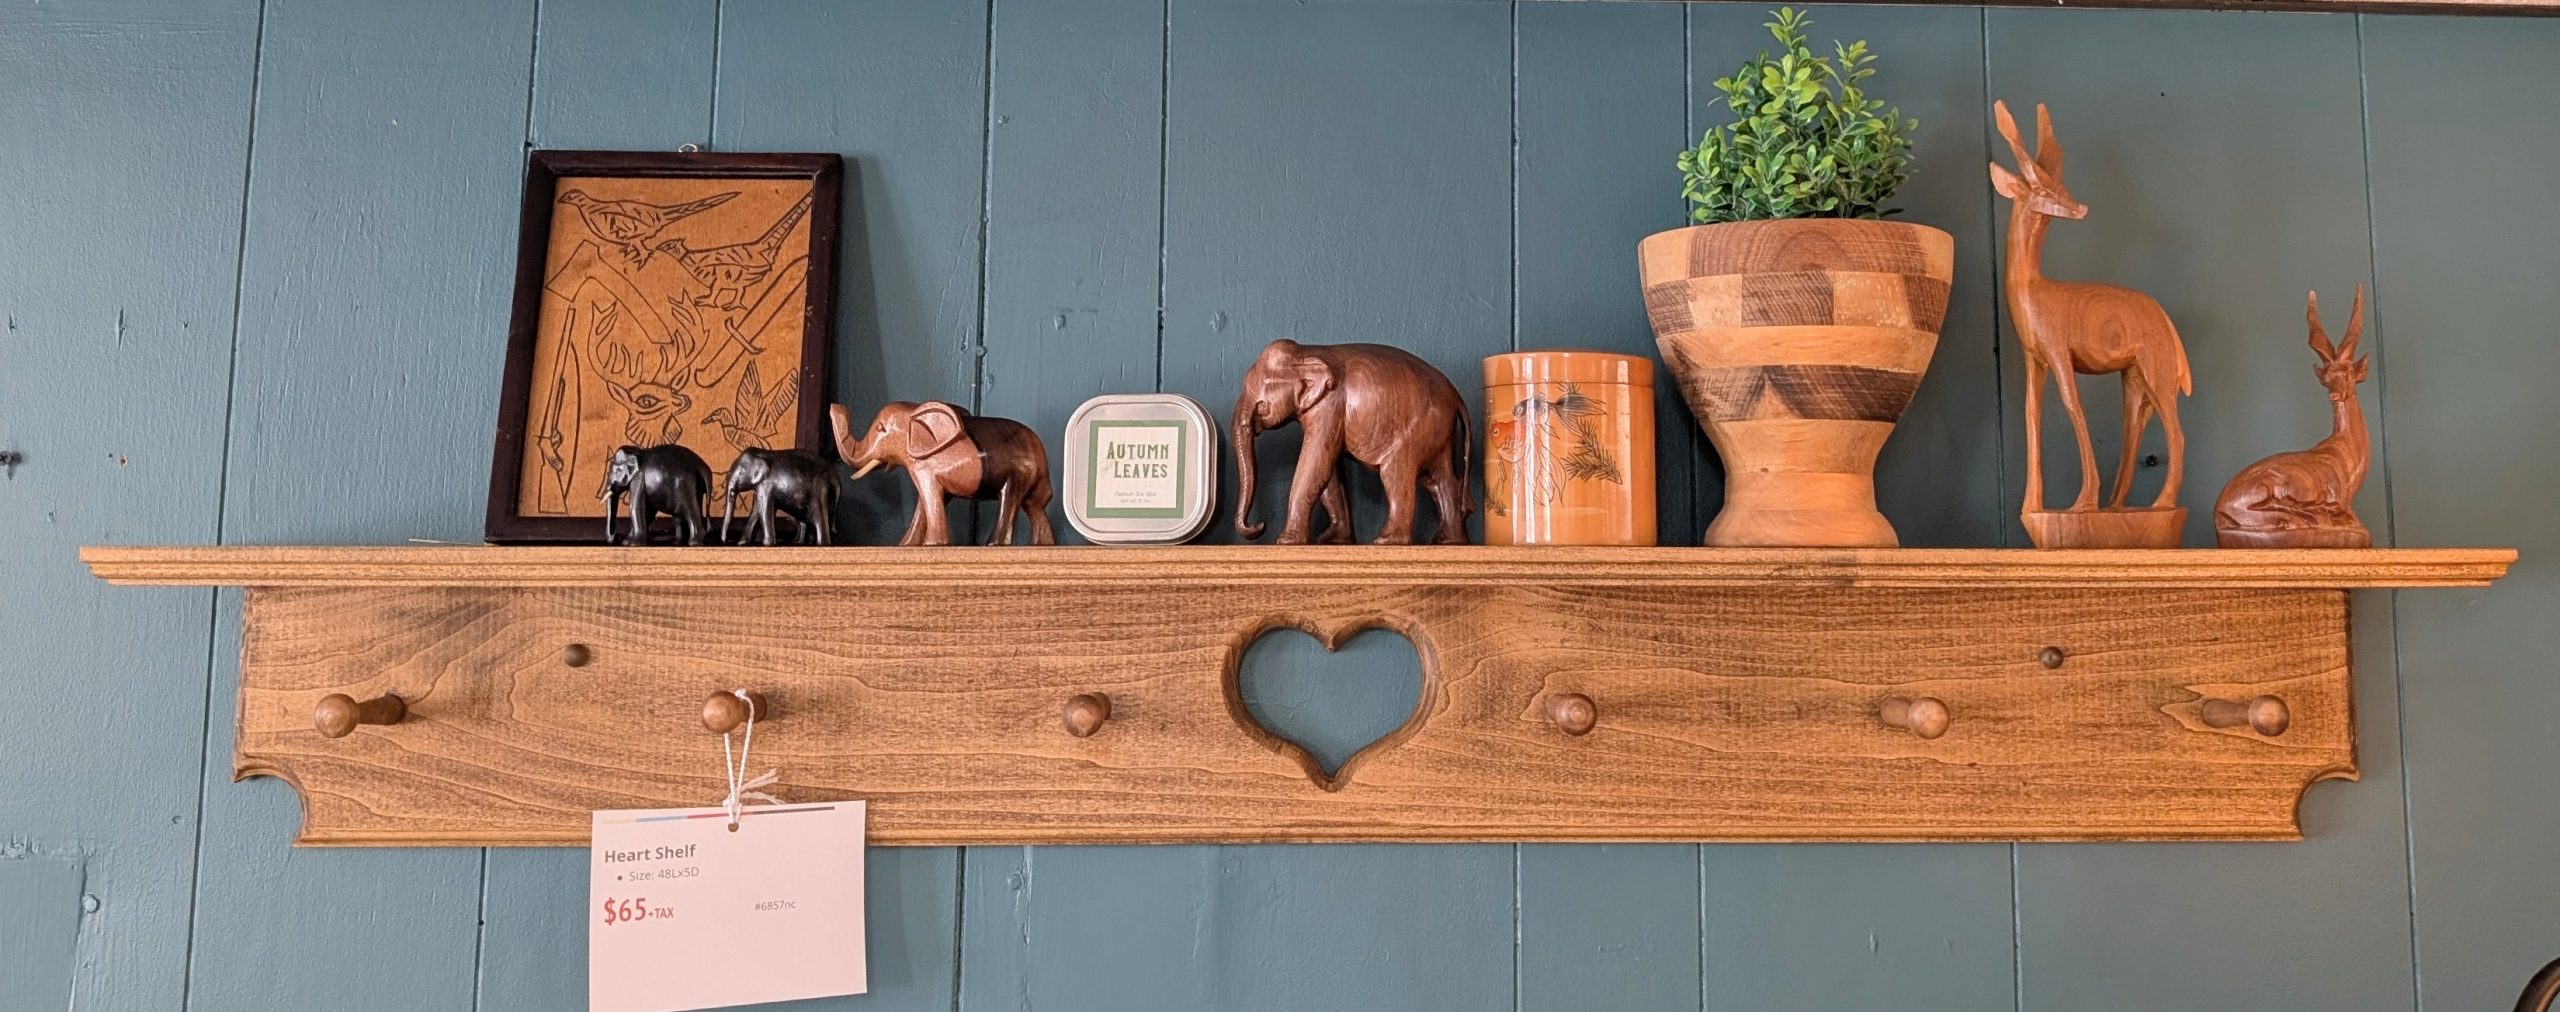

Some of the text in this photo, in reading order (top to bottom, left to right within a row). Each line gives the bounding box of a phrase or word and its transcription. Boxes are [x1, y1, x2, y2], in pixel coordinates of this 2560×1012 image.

[1106, 441, 1169, 460] AUTUMN
[1114, 461, 1168, 479] LEAVES
[604, 844, 697, 864] Heart Shelf
[629, 866, 700, 882] Size: 48Lx5D
[754, 900, 797, 911] #6857nc
